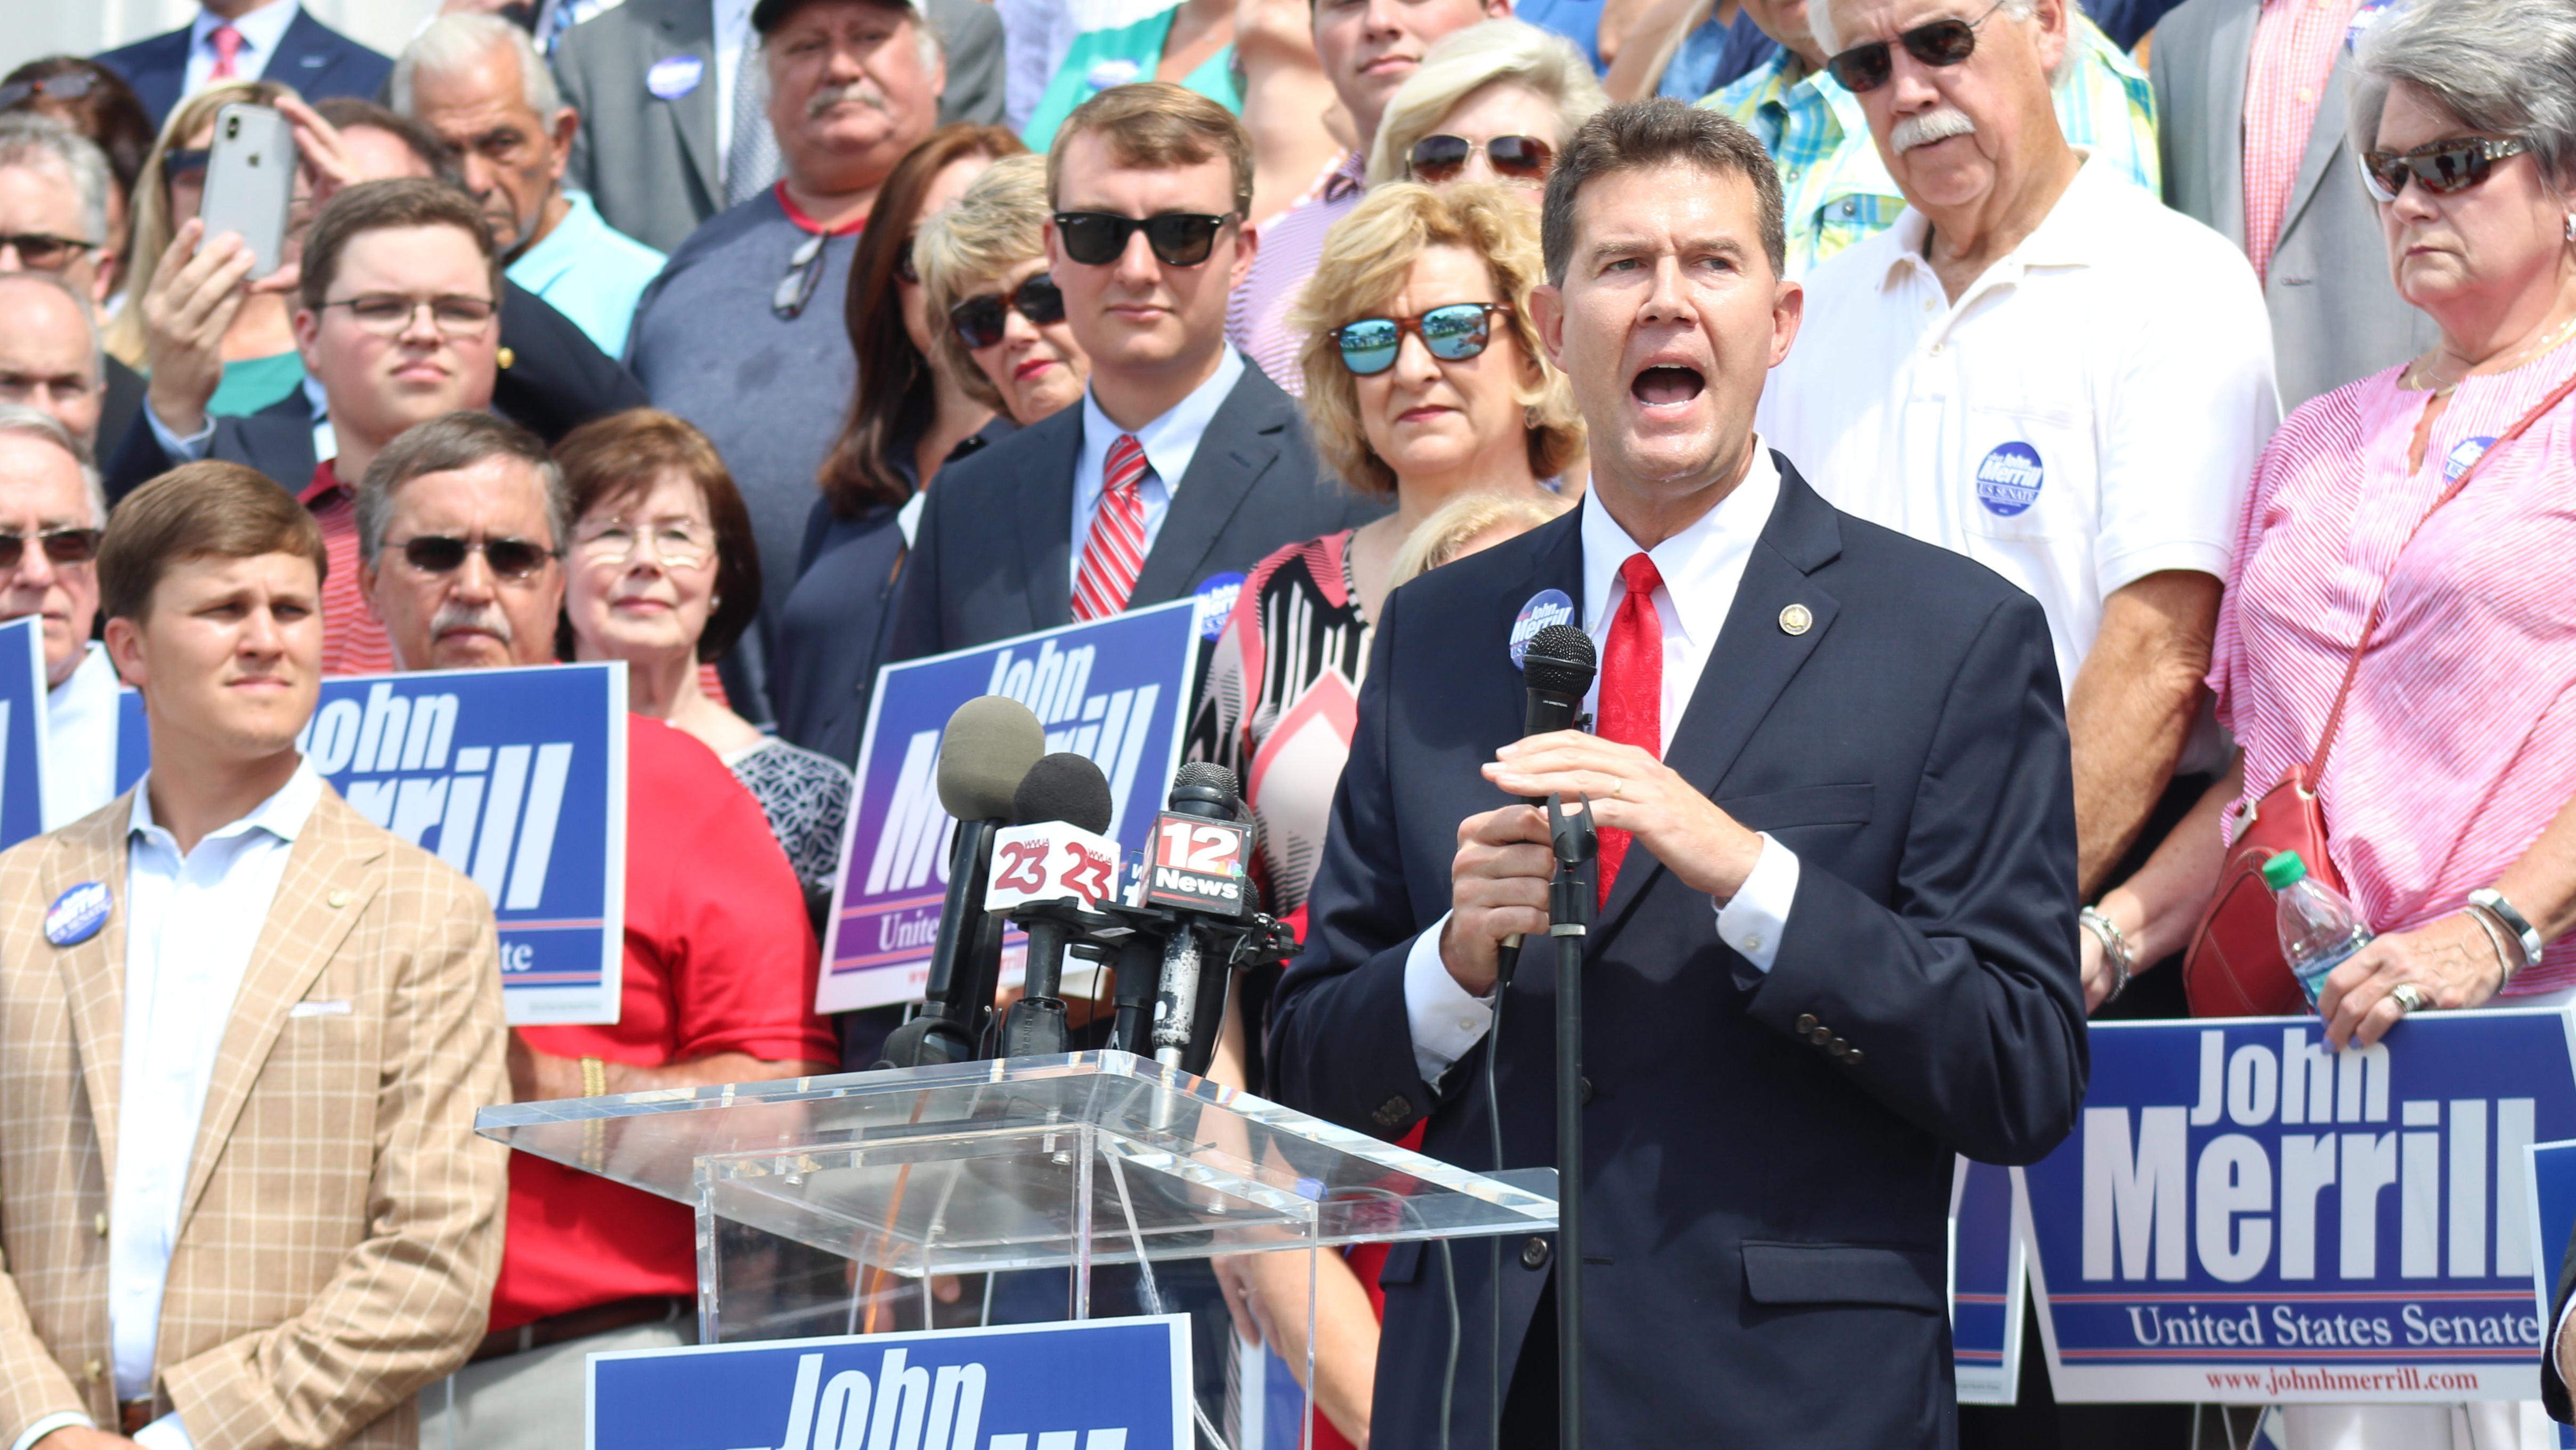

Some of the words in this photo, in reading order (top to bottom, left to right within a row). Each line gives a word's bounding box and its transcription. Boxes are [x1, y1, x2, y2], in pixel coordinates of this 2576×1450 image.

[1977, 459, 2043, 488] Merrill
[1528, 602, 1558, 621] John
[994, 841, 1050, 895] 23
[1162, 822, 1239, 873] 12
[1060, 841, 1113, 907] 23
[1155, 867, 1239, 900] News
[879, 909, 940, 953] Unite
[2191, 1027, 2390, 1127] John
[2082, 1098, 2536, 1283] Merrill
[2127, 1305, 2264, 1347] United
[2272, 1304, 2392, 1346] States
[2401, 1303, 2541, 1346] Senate
[775, 1347, 987, 1450] John
[2205, 1366, 2480, 1396] www.johnhmerrill.com
